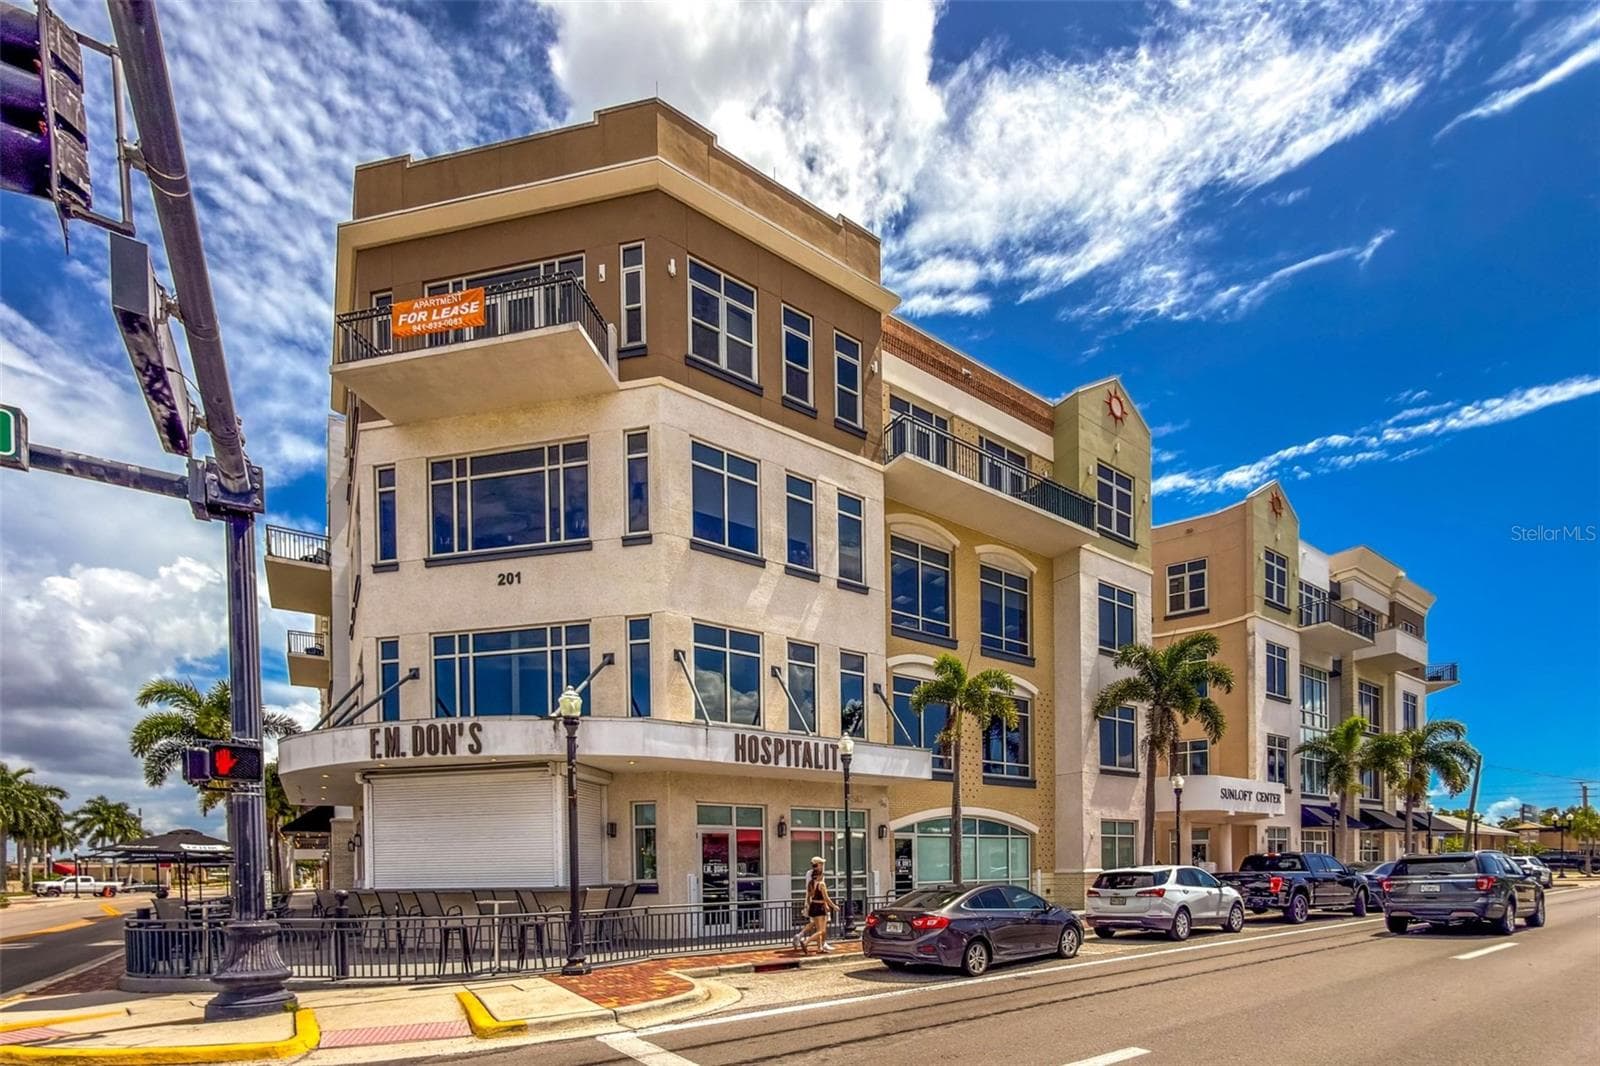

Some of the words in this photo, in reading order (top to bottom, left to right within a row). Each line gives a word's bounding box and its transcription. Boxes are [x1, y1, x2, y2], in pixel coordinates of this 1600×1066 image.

[413, 293, 462, 309] APARTMENT
[398, 310, 428, 326] FOR
[432, 301, 480, 320] LEASE
[497, 571, 521, 586] 201
[369, 726, 407, 759] F.M.
[412, 722, 483, 757] DON'S
[734, 733, 840, 770] HOSPITALIT
[1220, 788, 1253, 801] SUNLOFT
[1256, 791, 1281, 803] CENTER
